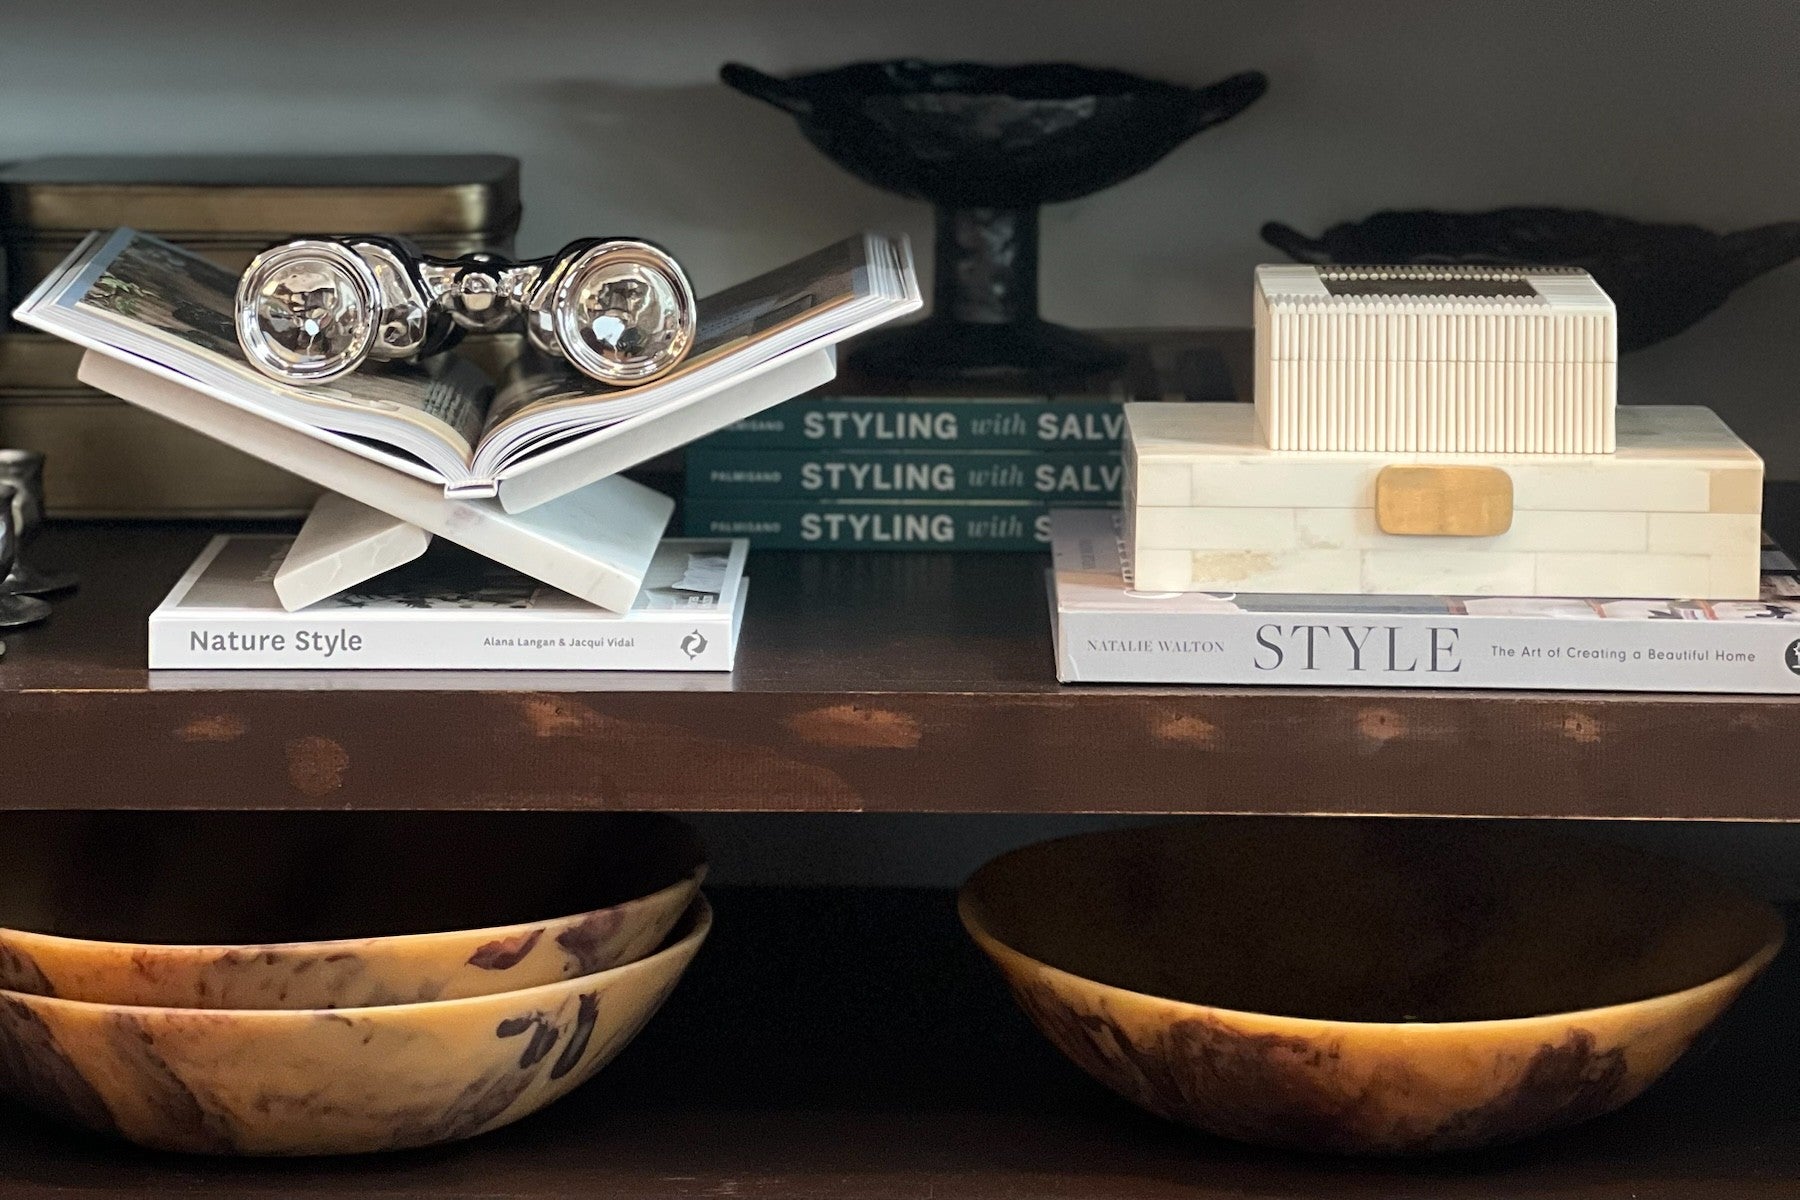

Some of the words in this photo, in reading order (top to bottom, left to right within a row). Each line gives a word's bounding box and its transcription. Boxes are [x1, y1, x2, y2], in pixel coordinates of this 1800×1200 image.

[803, 411, 958, 440] STYLING
[970, 412, 1027, 437] with
[1037, 412, 1124, 441] SALV
[801, 462, 956, 491] STYLING
[968, 463, 1024, 488] with
[1034, 463, 1122, 492] SALV
[800, 513, 955, 542] STYLING
[967, 514, 1023, 539] with
[190, 630, 286, 651] Nature
[295, 628, 362, 657] Style
[483, 637, 514, 647] Alana
[517, 637, 555, 649] Langan
[558, 637, 566, 647] &
[569, 636, 604, 649] Jacqui
[607, 637, 635, 648] Vidal
[1087, 640, 1153, 652] NATALIE
[1158, 640, 1225, 653] WALTON
[1252, 623, 1463, 673] STYLE
[1491, 645, 1515, 657] The
[1521, 646, 1542, 658] Art
[1547, 646, 1562, 658] of
[1566, 646, 1627, 663] Creating
[1633, 651, 1641, 660] a
[1648, 648, 1709, 662] Beautiful
[1716, 650, 1756, 662] Home
